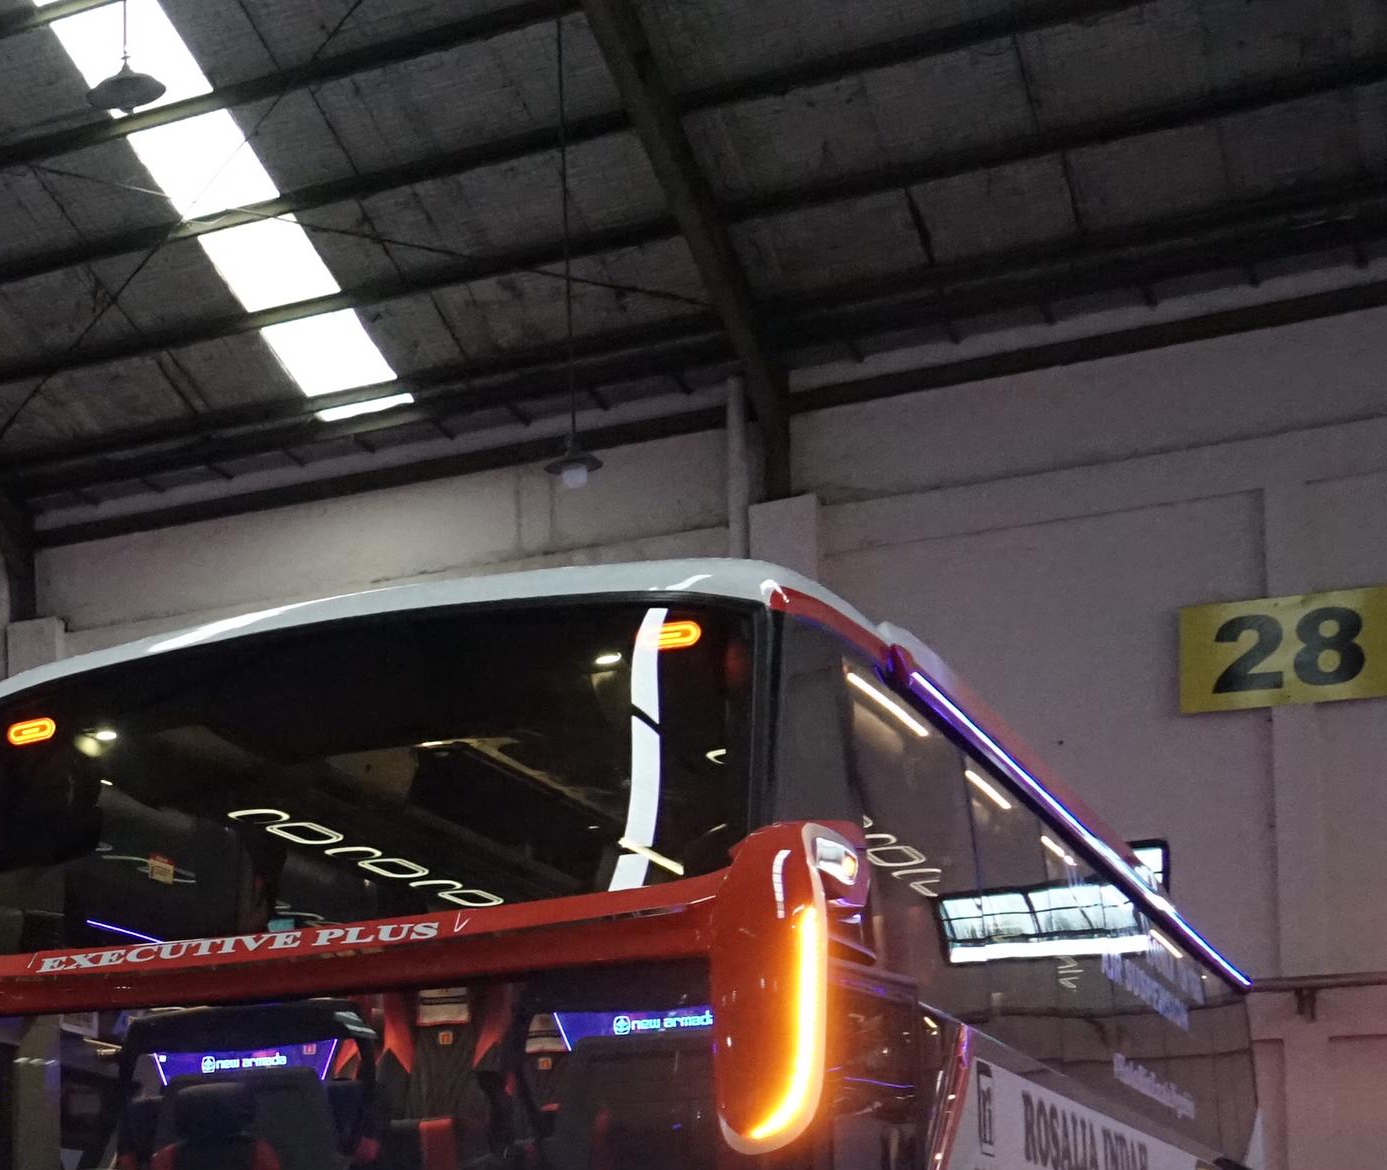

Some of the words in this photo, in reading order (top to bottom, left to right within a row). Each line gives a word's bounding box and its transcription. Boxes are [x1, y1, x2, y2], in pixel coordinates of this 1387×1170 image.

[1213, 606, 1366, 694] 28
[36, 930, 302, 974] EXECUTIVE
[312, 921, 440, 946] PLUS
[664, 1010, 713, 1028] armad
[216, 1057, 240, 1070] new
